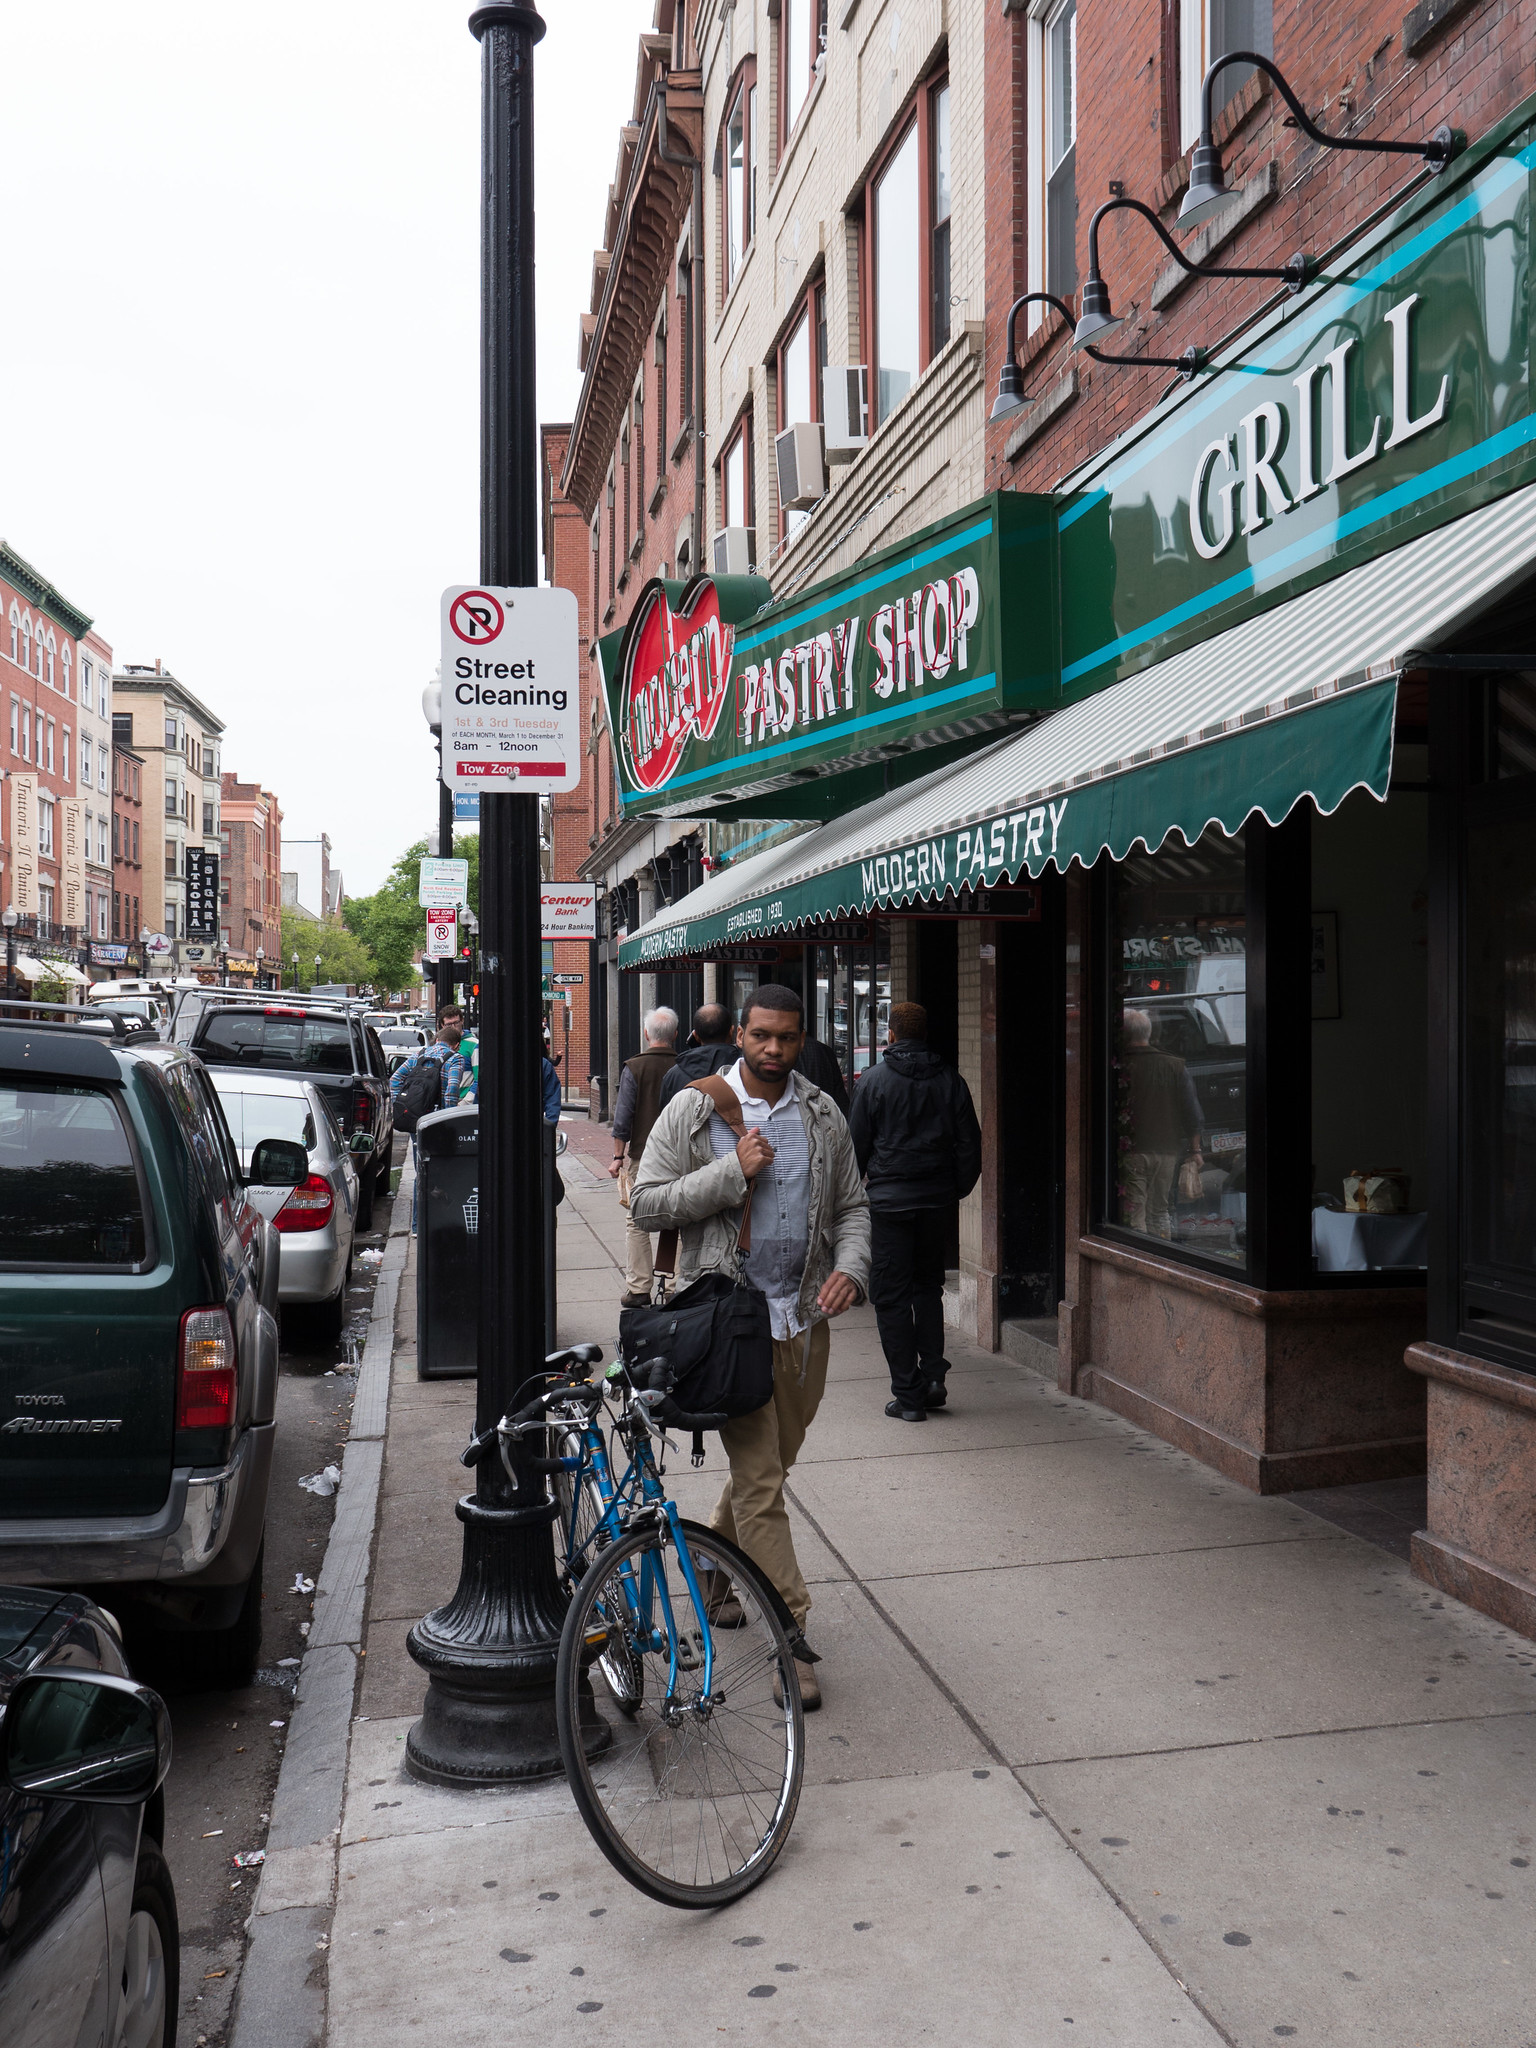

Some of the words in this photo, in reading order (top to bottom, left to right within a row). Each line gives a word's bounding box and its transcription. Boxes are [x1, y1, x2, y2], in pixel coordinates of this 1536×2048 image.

[1189, 292, 1450, 560] GRILL
[455, 656, 535, 680] Street
[736, 616, 860, 746] PASTRY
[867, 566, 980, 700] SHOP
[455, 683, 568, 711] Cleaning
[455, 717, 471, 727] 1st
[475, 717, 484, 727] &
[489, 717, 509, 728] 3rd
[513, 718, 560, 731] Tuesday
[453, 741, 479, 751] 8am
[499, 741, 538, 752] 12noon
[461, 763, 485, 774] Tow
[491, 763, 521, 775] Zone
[17, 778, 32, 836] Trattoria
[66, 803, 81, 856] Trattoria
[861, 838, 946, 899] MODERN
[955, 798, 1069, 878] PASTRY
[18, 863, 33, 908] Panino
[66, 880, 81, 920] Panino
[190, 853, 201, 927] VITTORIA
[204, 865, 214, 931] SIGARI
[540, 895, 594, 907] Century
[551, 923, 567, 931] Hour
[568, 923, 594, 932] Banking
[555, 908, 579, 916] Bank
[727, 908, 763, 932] ESTABLISHED
[767, 901, 783, 920] 1930
[641, 933, 663, 957] MODERN
[663, 925, 688, 949] PASTRY
[15, 1395, 66, 1405] TOYOTA
